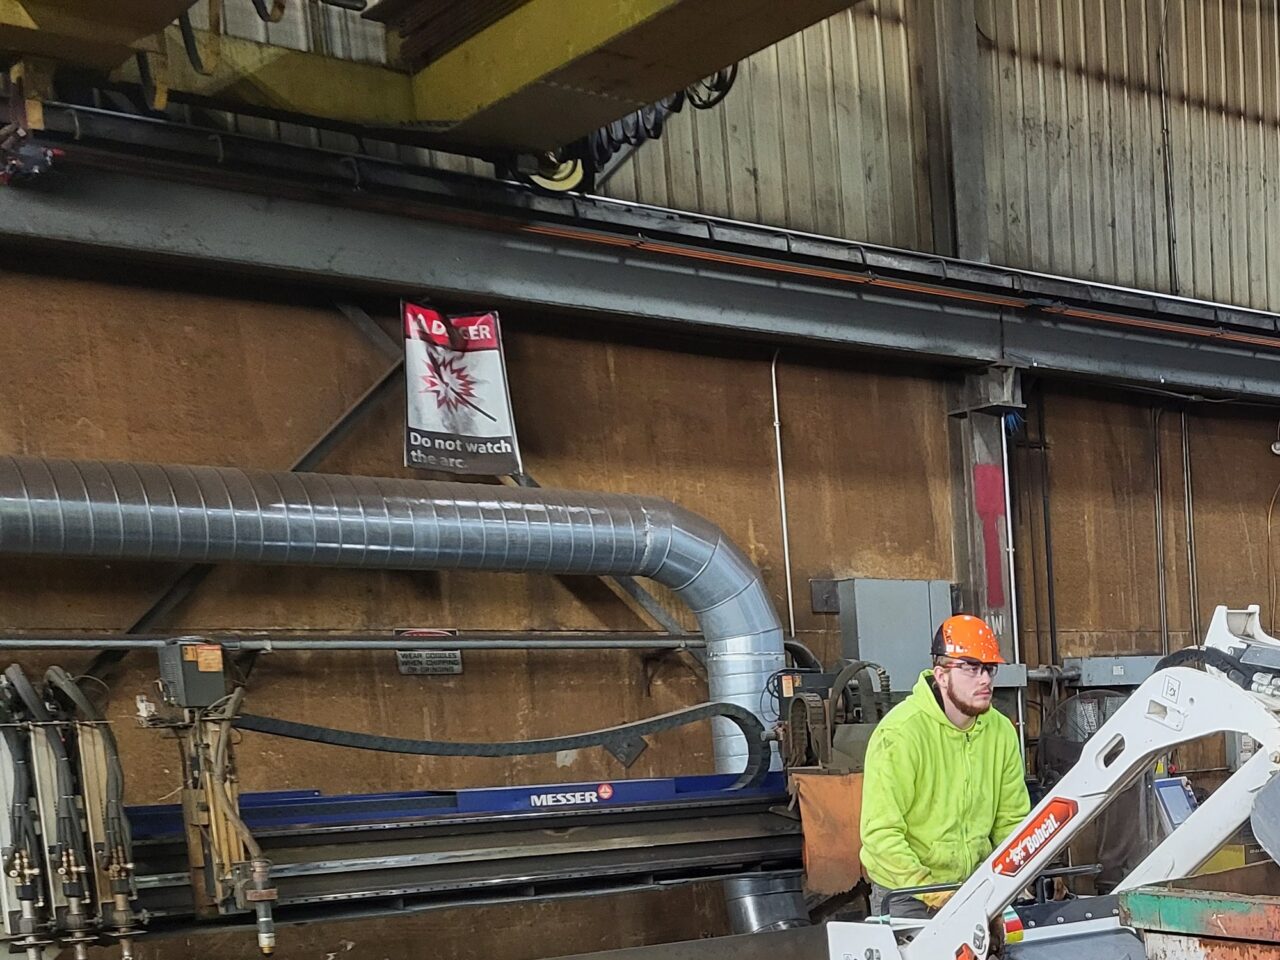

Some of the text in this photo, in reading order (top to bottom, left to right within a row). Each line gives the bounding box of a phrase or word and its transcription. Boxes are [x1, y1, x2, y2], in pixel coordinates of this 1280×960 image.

[431, 319, 492, 340] DGER
[410, 432, 512, 453] Do not watch
[410, 450, 437, 465] the
[530, 791, 598, 807] MESSER
[1025, 812, 1060, 855] Bobcat
